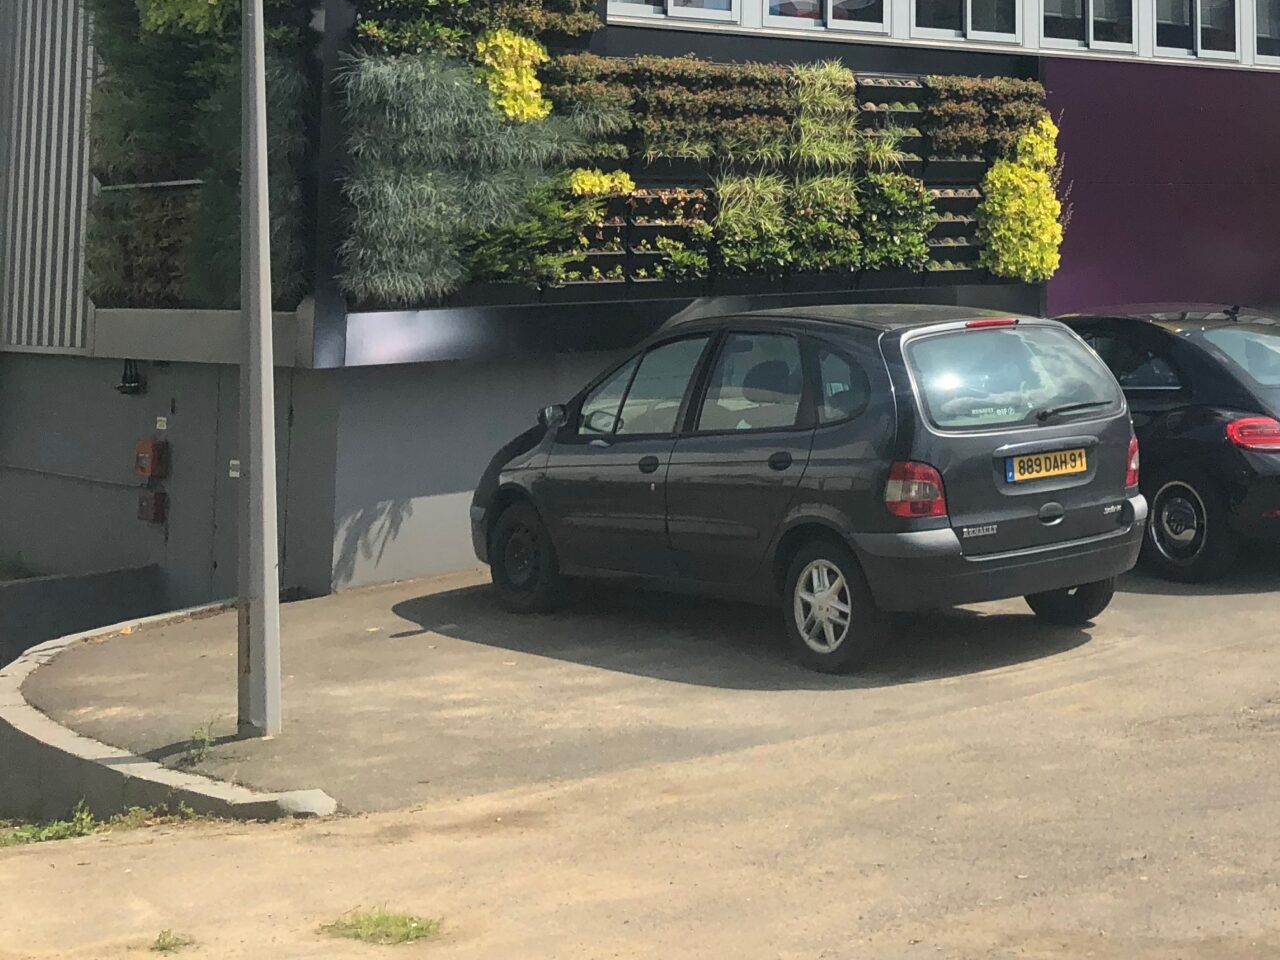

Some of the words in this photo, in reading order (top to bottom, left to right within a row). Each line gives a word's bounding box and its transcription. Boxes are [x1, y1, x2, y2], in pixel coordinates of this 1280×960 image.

[1018, 457, 1042, 476] 889
[1044, 453, 1068, 473] DAH
[1069, 451, 1084, 469] 91
